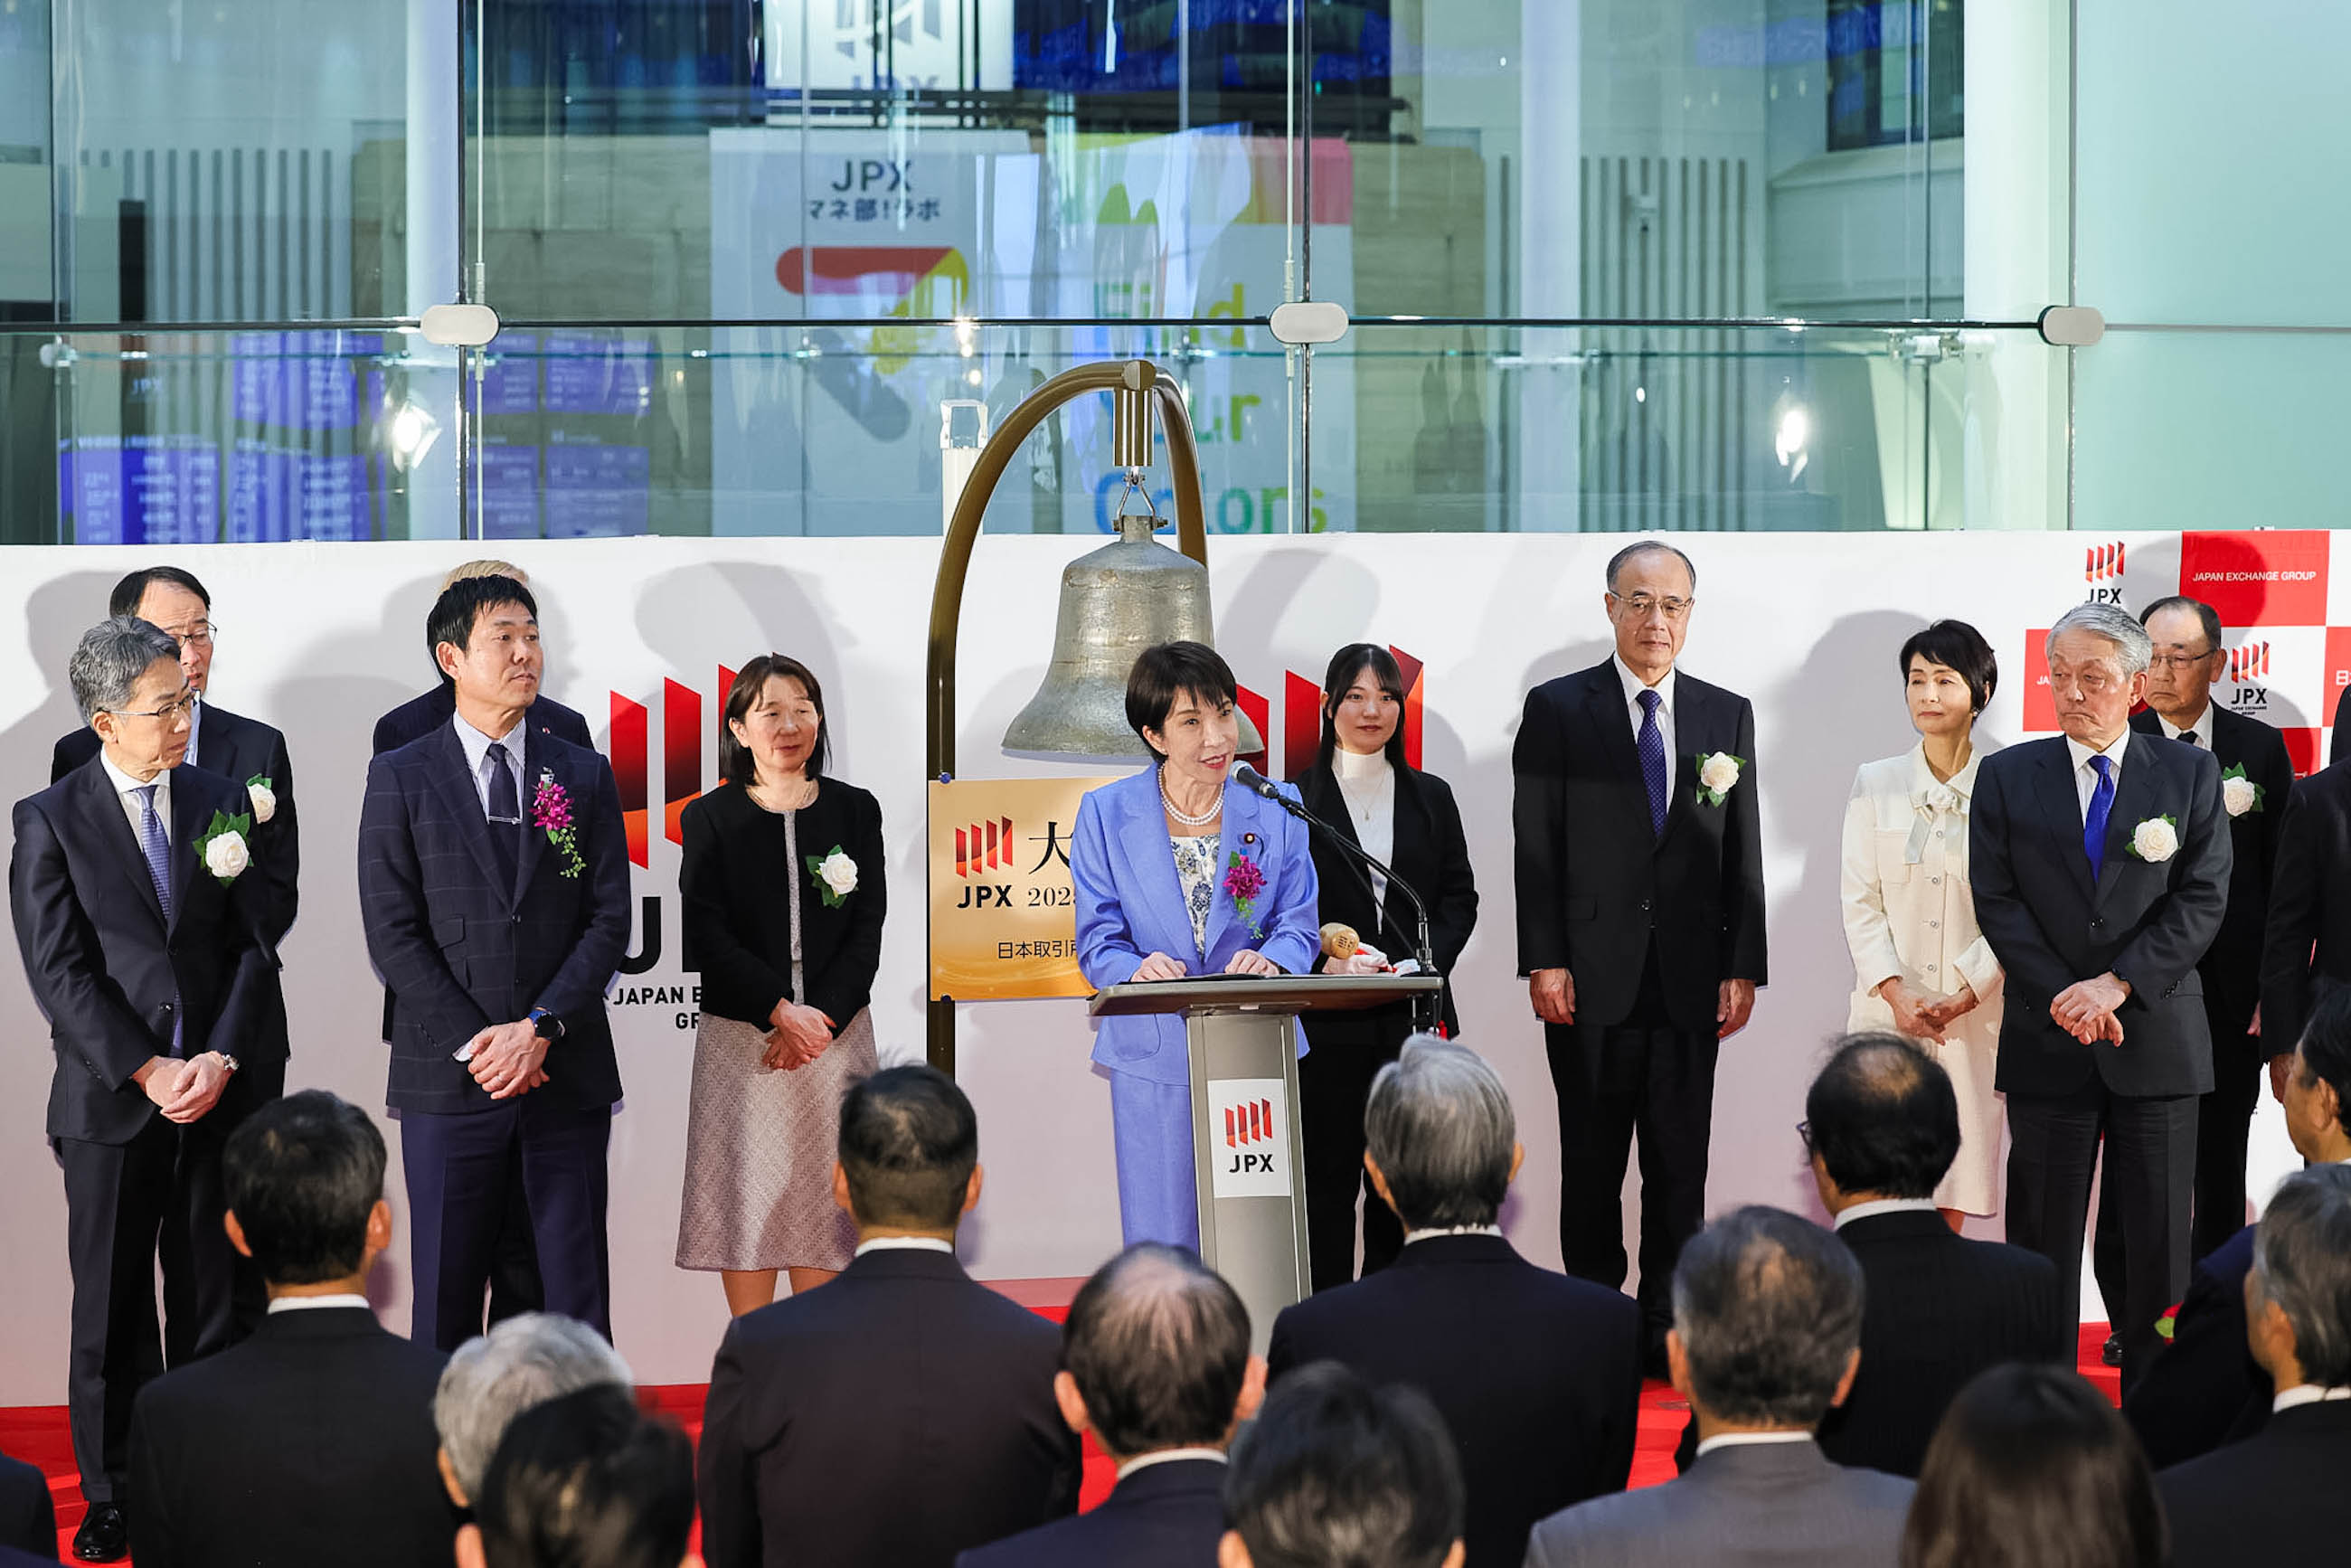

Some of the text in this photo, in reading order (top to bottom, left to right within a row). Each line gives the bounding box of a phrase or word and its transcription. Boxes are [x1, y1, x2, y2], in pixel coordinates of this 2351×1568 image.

[831, 159, 912, 192] JPX
[2193, 571, 2317, 581] JAPAN EXCHANGE GROUP
[2231, 688, 2267, 704] JPX
[957, 884, 1013, 908] JPX
[1028, 886, 1076, 907] 202
[613, 987, 684, 1006] JAPAN
[1229, 1154, 1274, 1174] JPX
